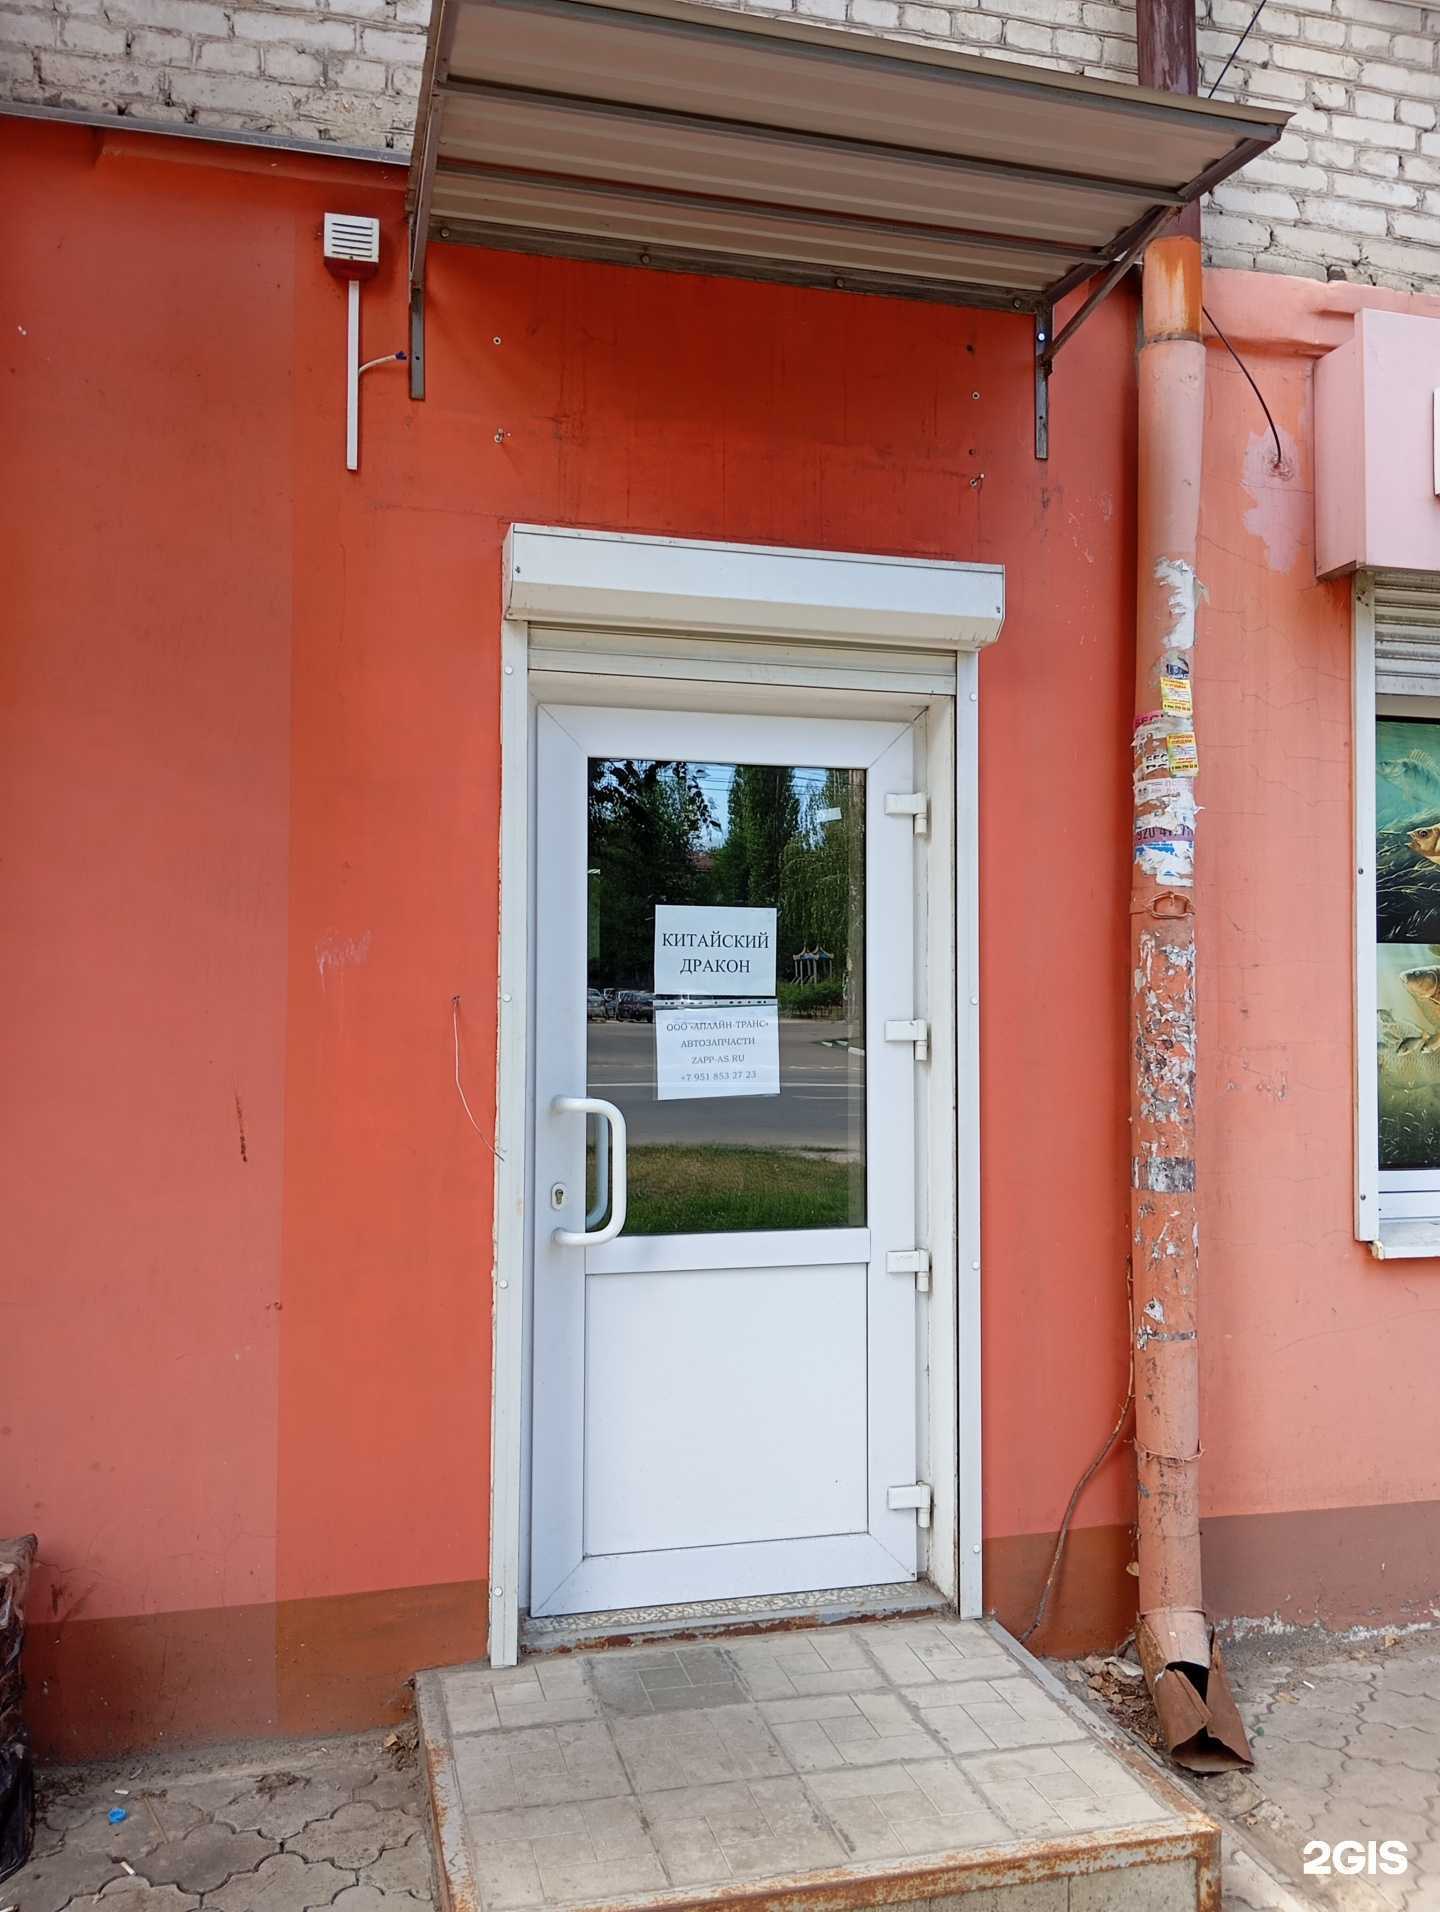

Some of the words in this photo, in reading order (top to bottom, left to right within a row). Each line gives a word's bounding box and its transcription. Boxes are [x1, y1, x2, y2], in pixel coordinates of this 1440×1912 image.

[662, 930, 769, 949] КИТАЙСКИЙ
[680, 958, 751, 974] ДРАКОН
[666, 1023, 688, 1032] ООО
[681, 1037, 756, 1049] АВТОЗАПЧАСТИ
[681, 1073, 692, 1081] +7
[694, 1072, 710, 1081] 951
